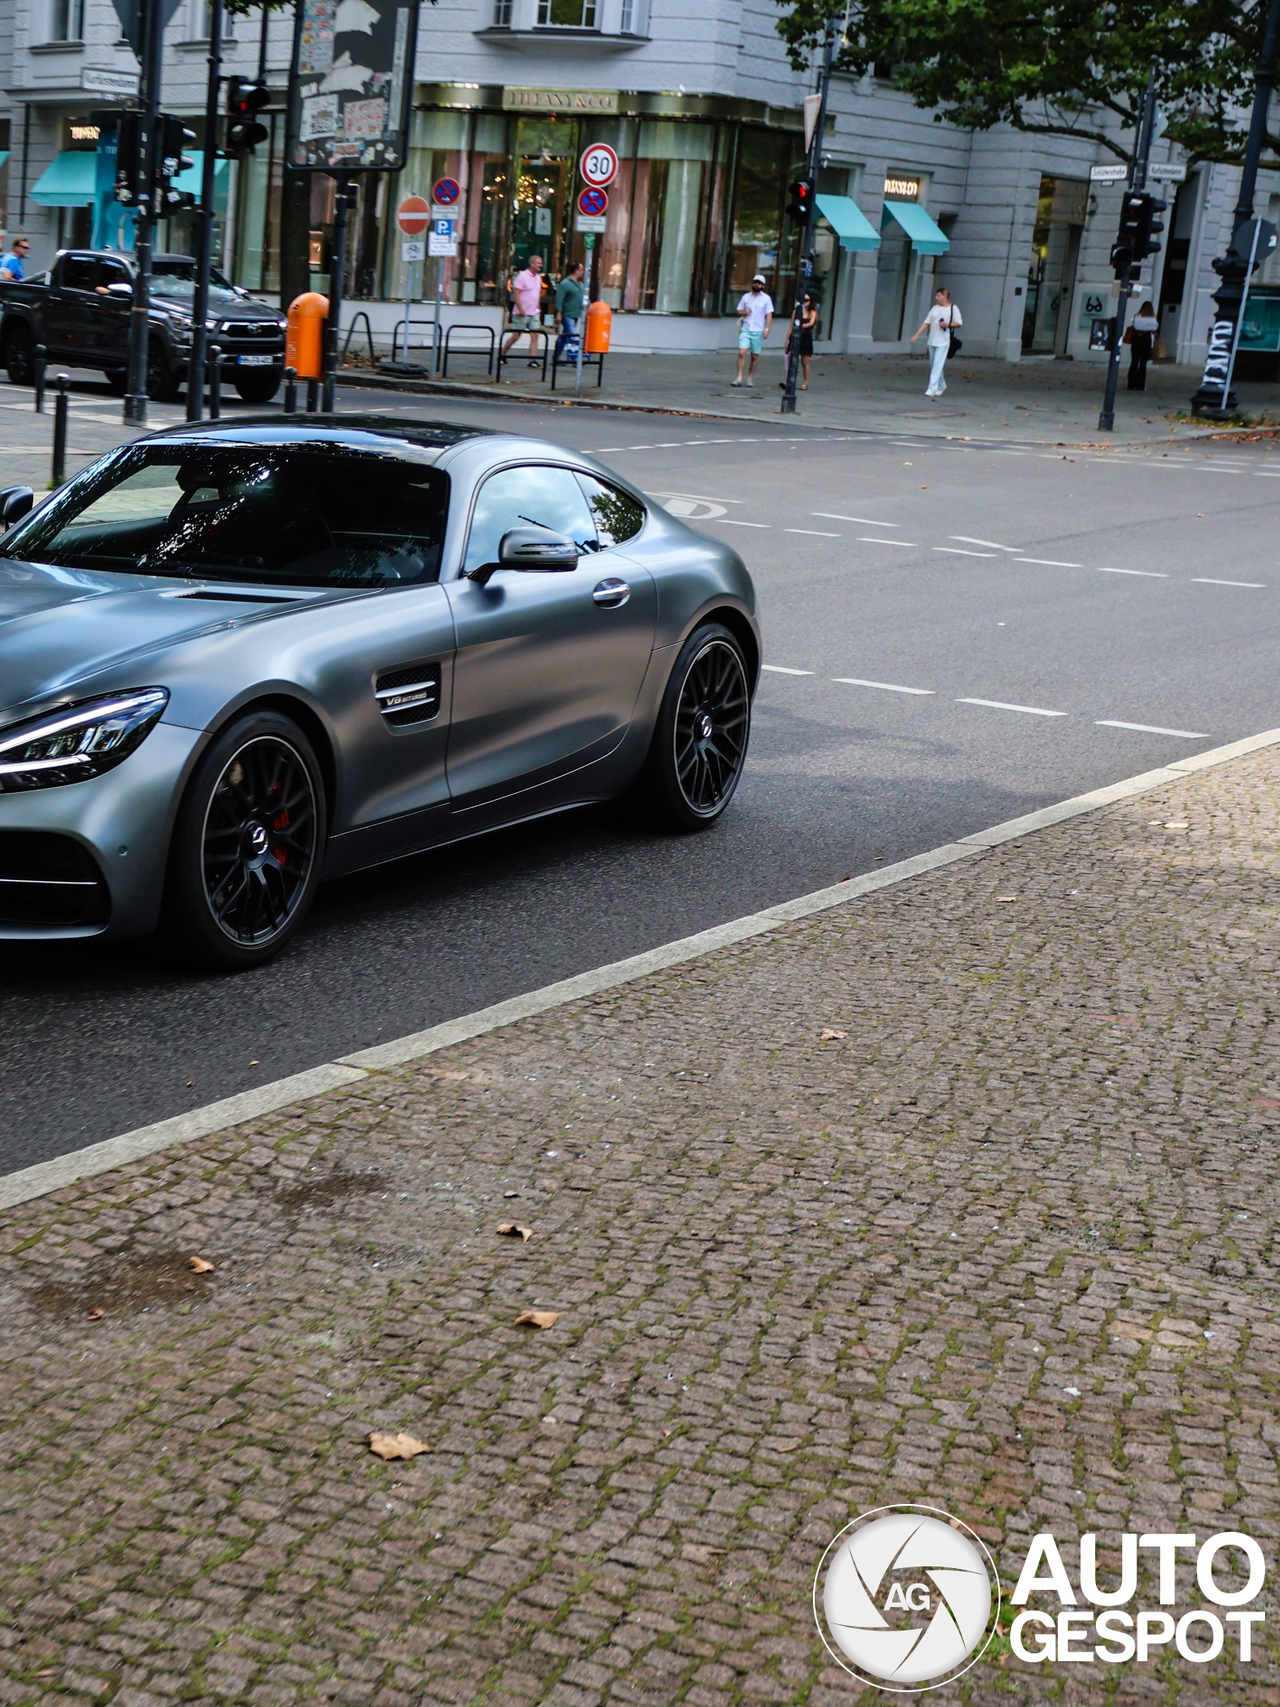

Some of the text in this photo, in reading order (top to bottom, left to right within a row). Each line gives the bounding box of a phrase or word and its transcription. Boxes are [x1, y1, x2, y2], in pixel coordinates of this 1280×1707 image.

[588, 155, 610, 176] 30
[437, 220, 449, 234] P
[386, 696, 402, 706] V8
